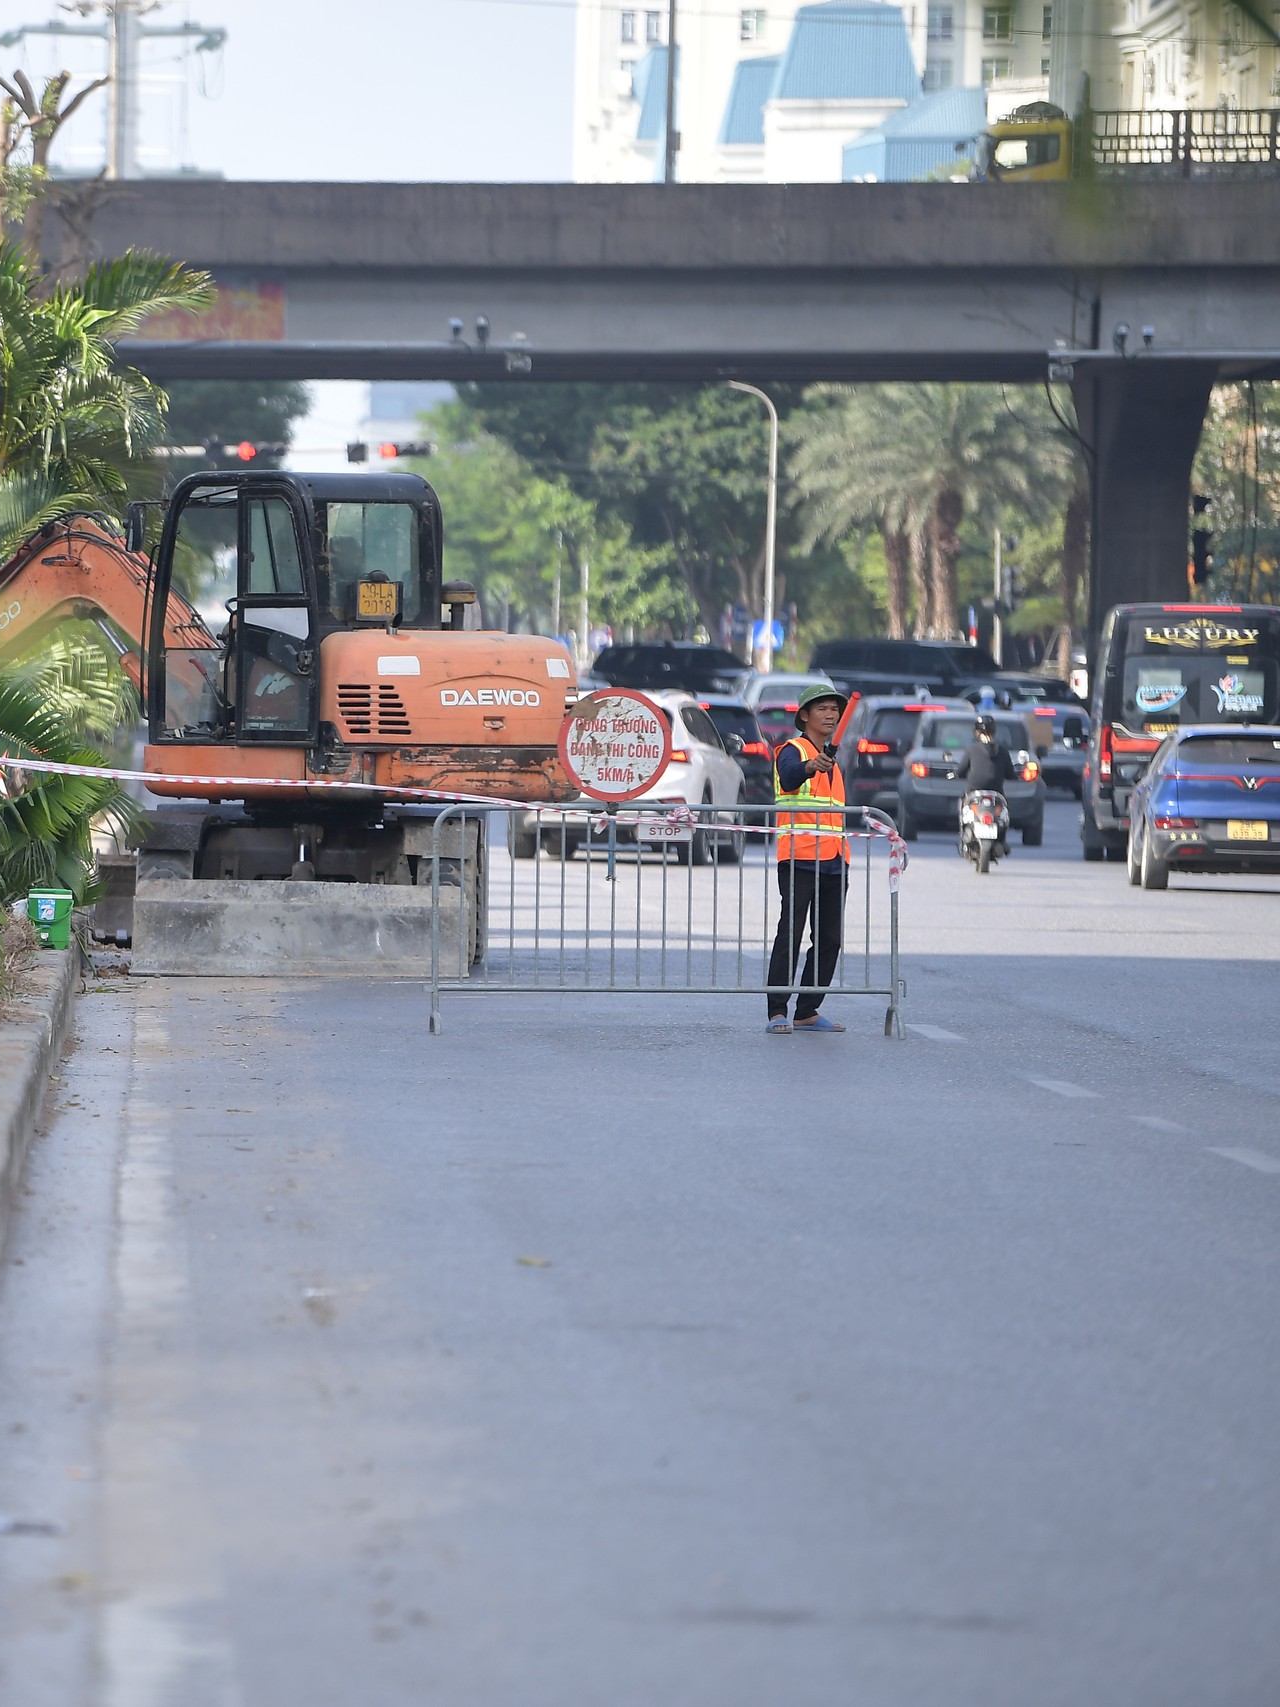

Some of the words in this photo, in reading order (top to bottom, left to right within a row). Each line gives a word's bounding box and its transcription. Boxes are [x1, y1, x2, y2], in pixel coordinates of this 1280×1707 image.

[1144, 626, 1260, 641] LUXURY
[440, 688, 541, 707] DAEWOO
[649, 827, 681, 836] STOP
